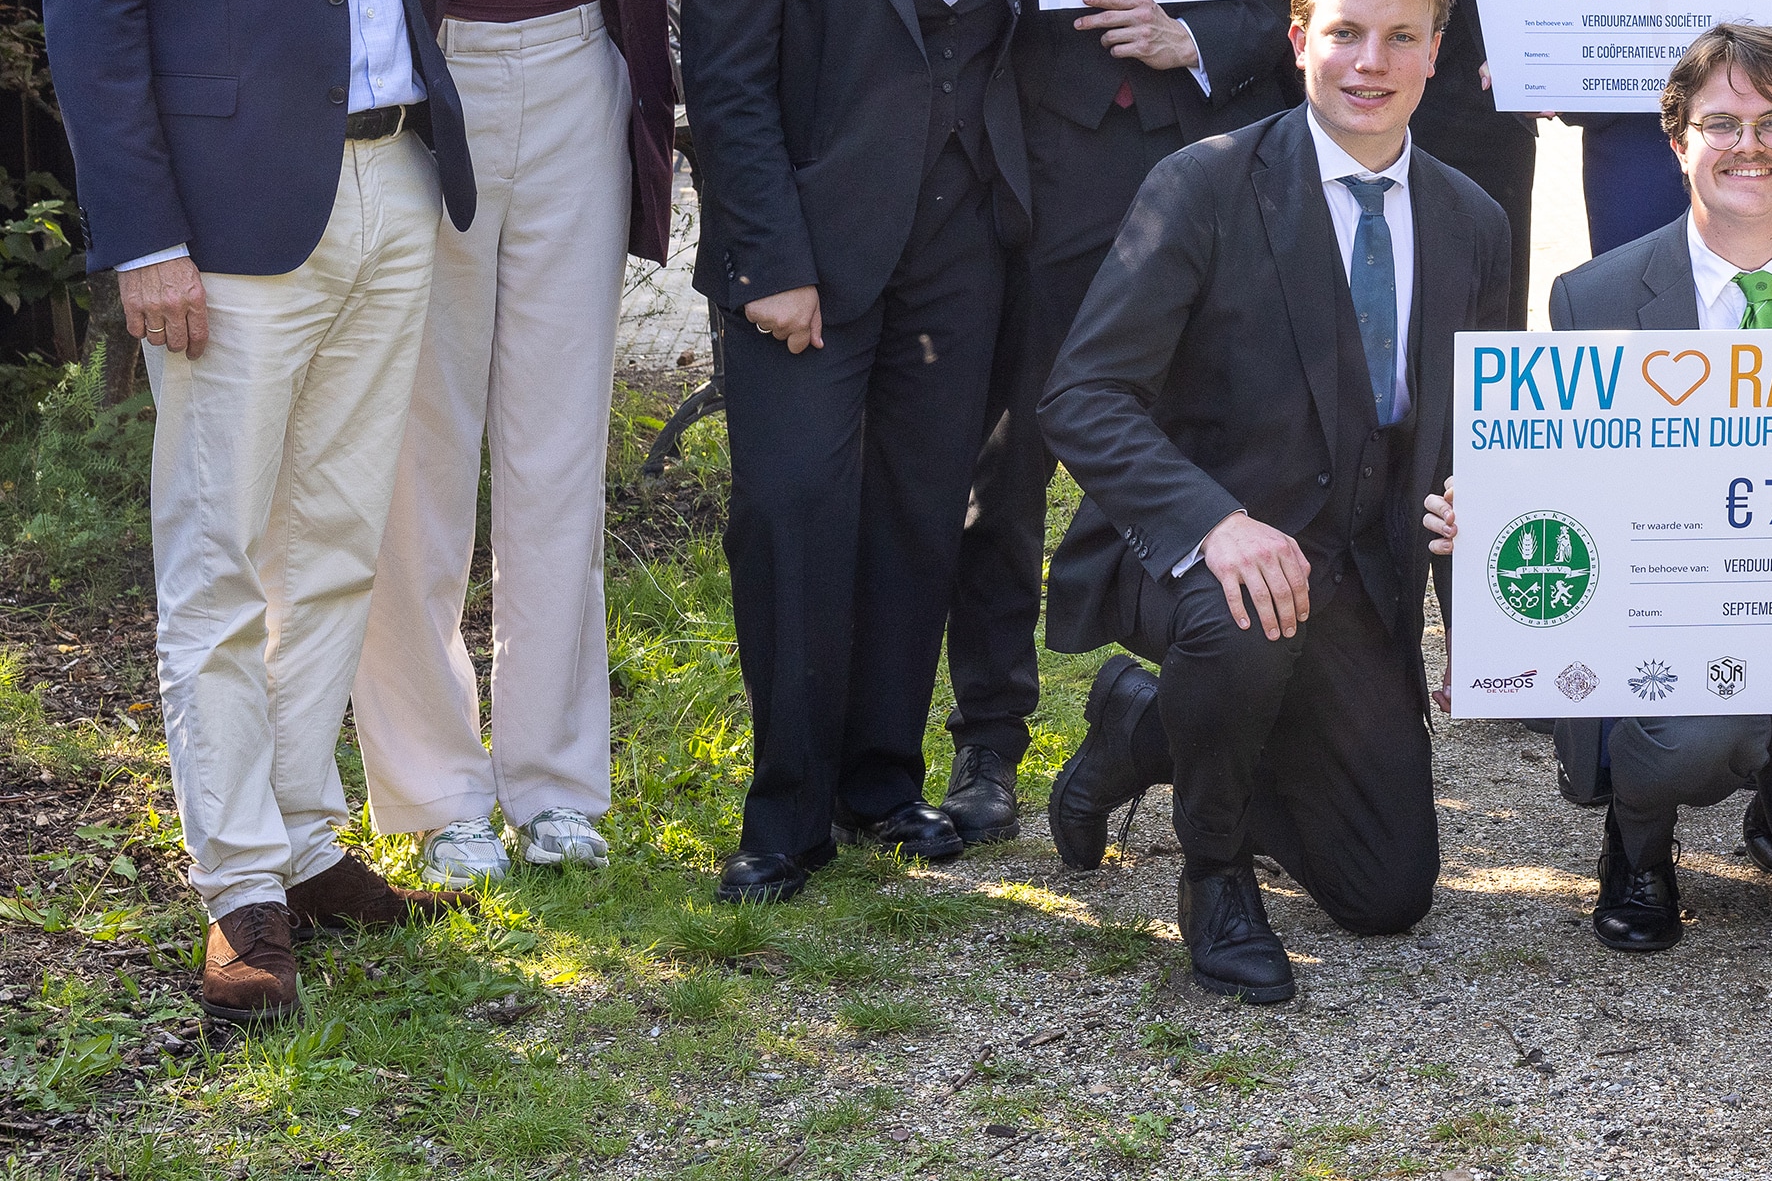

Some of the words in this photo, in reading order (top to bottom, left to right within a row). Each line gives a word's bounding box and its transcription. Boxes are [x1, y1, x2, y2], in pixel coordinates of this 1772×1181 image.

[1535, 19, 1561, 27] behoeve
[1582, 14, 1663, 28] VERDUURZAMING
[1665, 13, 1712, 28] SOCIËTEIT
[1582, 46, 1594, 59] DE
[1597, 43, 1666, 59] COÖPERATIEVE
[1582, 78, 1639, 91] SEPTEMBER
[1641, 78, 1666, 91] 2026
[1473, 345, 1624, 411] PKVV
[1471, 419, 1563, 450] SAMEN
[1573, 418, 1642, 449] VOOR
[1651, 417, 1700, 448] EEN
[1725, 477, 1754, 529] €
[1552, 512, 1587, 538] Kamer
[1631, 522, 1645, 530] Ter
[1647, 521, 1682, 530] waarde
[1684, 522, 1703, 530] van:
[1630, 565, 1647, 574] Ten
[1649, 565, 1689, 573] behoeve
[1690, 565, 1709, 573] van:
[1628, 609, 1663, 617] Datum:
[1710, 659, 1743, 684] SSR
[1470, 677, 1534, 689] ASOPOS
